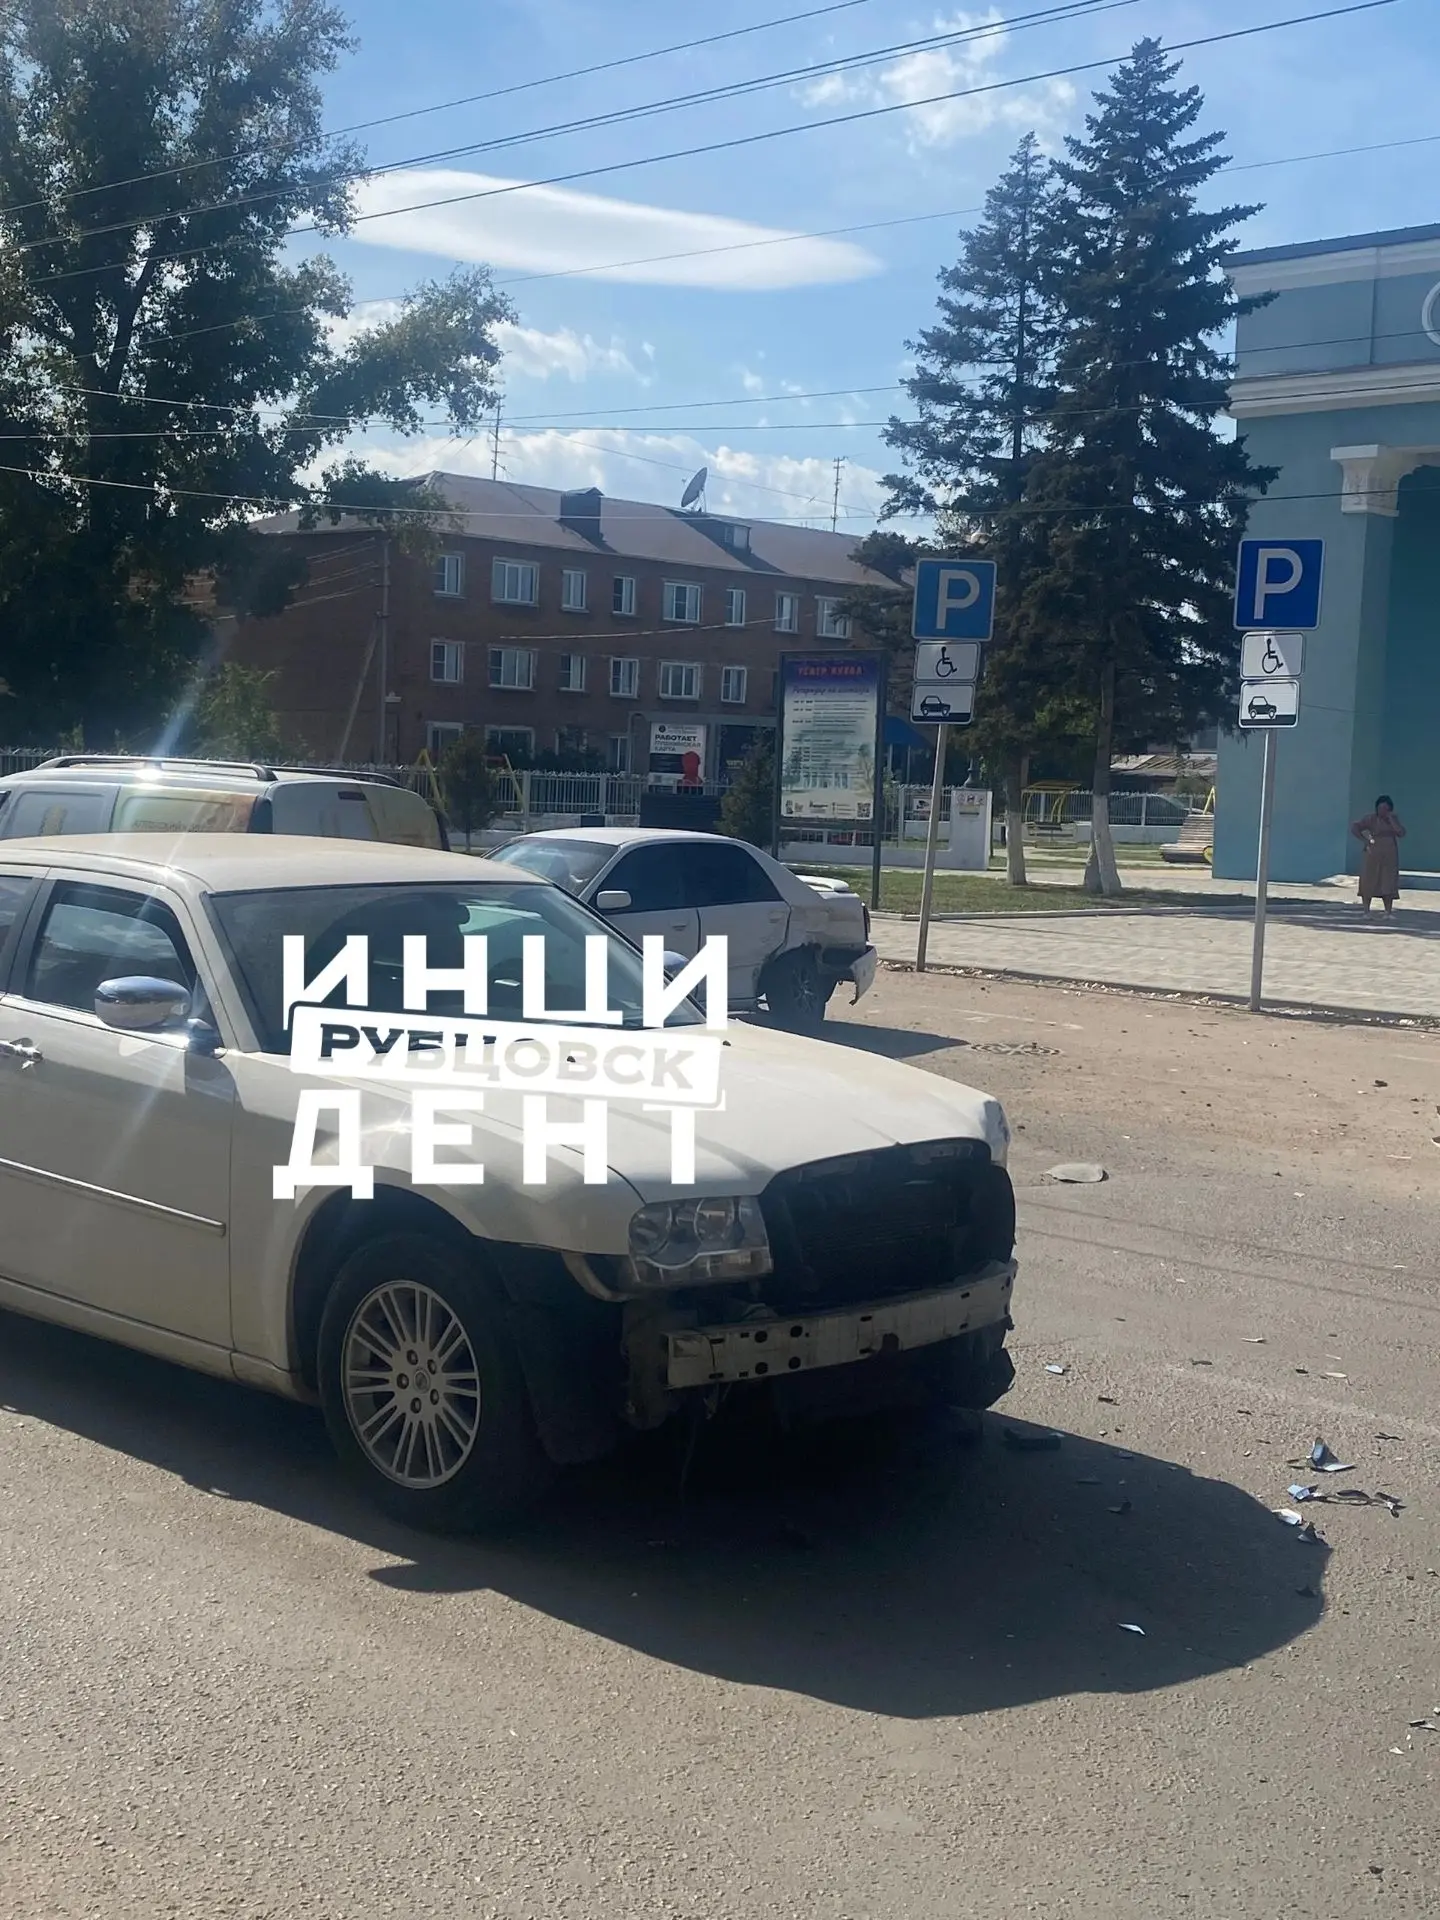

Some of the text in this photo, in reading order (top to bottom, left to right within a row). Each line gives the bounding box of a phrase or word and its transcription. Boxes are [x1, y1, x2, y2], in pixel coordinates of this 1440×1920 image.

[936, 569, 980, 630] P
[1253, 548, 1303, 620] P
[655, 734, 697, 742] РАБОТАЕТ
